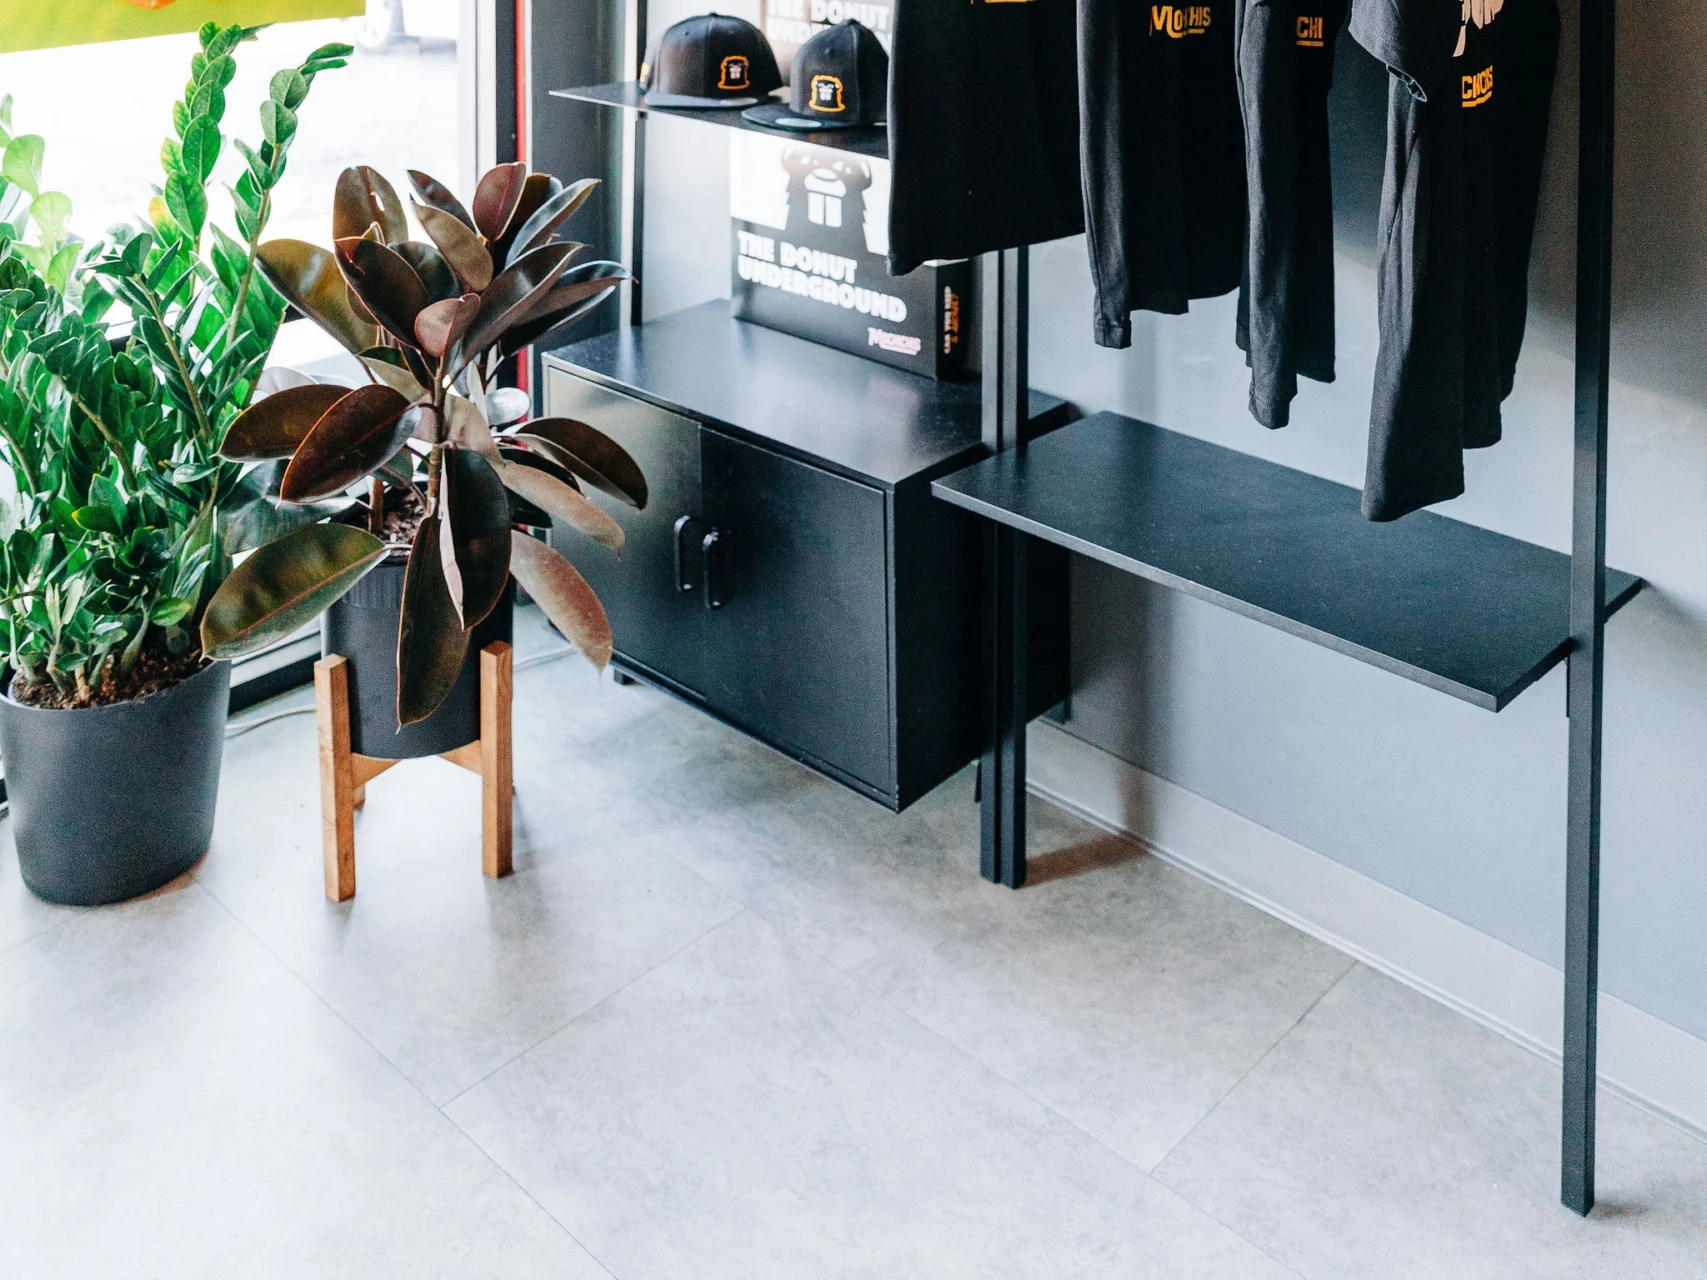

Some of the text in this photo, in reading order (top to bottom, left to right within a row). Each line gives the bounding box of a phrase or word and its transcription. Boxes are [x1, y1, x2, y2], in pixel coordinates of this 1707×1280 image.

[737, 230, 858, 284] THE DONUT
[738, 254, 908, 323] UNDERGROUND
